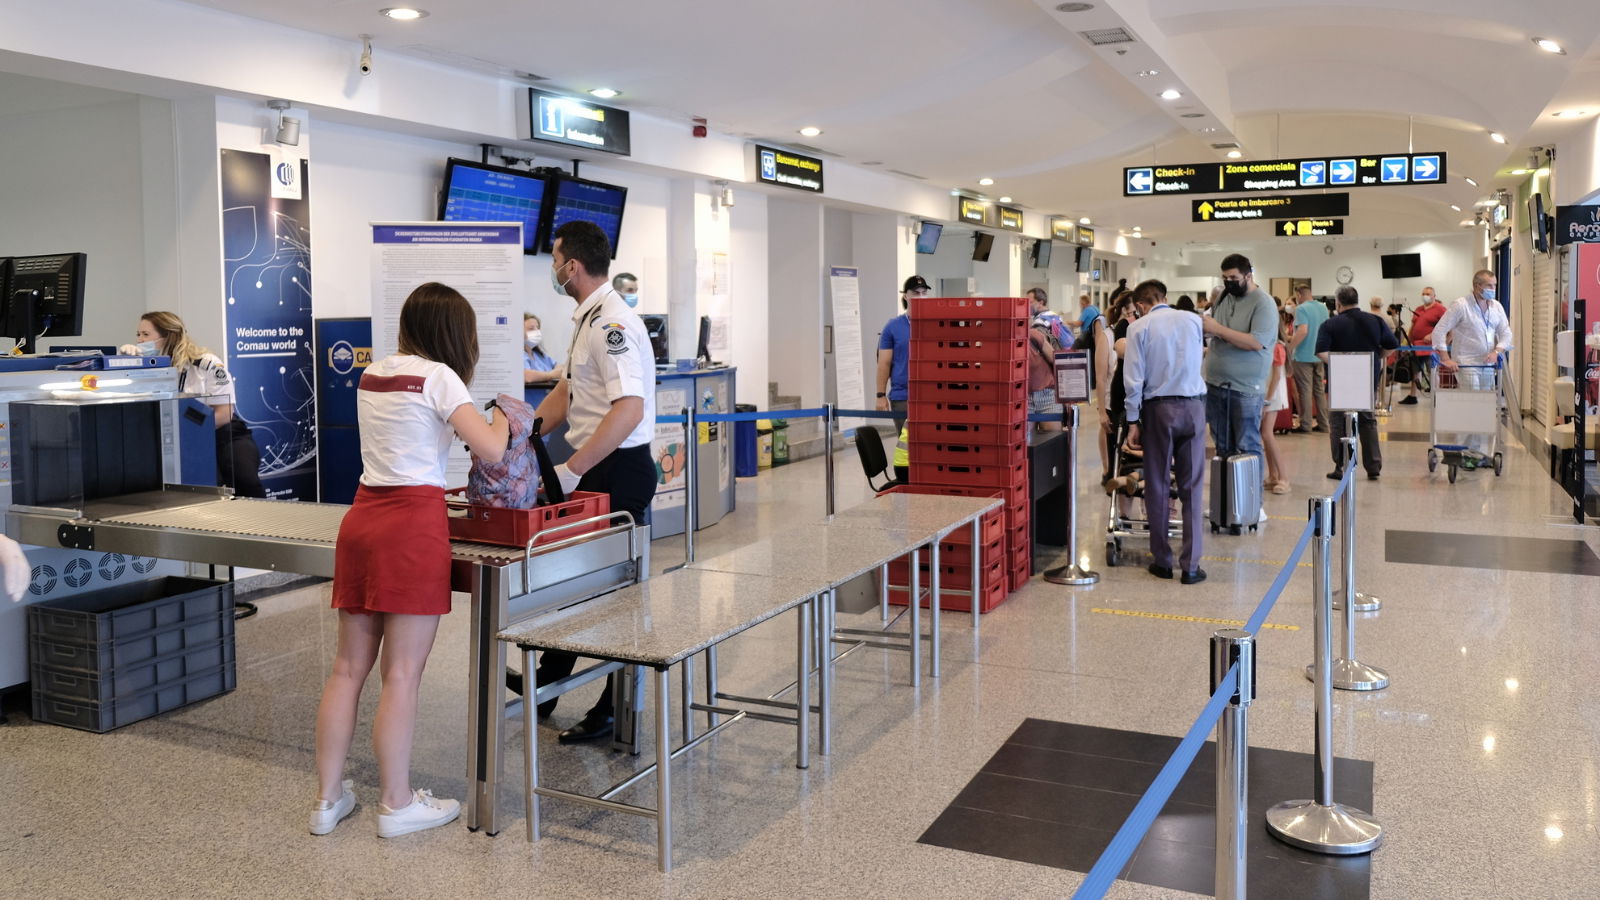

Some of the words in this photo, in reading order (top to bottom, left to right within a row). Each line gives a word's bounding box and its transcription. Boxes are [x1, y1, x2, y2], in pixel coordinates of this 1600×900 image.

[1360, 158, 1377, 168] Bar
[1155, 168, 1195, 178] Check-in
[1226, 165, 1248, 174] Zona
[1362, 175, 1376, 183] Bar
[1155, 181, 1190, 191] Check-in
[1243, 179, 1279, 190] Shopping
[1279, 179, 1297, 188] Area
[1214, 200, 1238, 208] Poarta
[1286, 197, 1291, 205] 3
[1214, 210, 1242, 219] Boarding
[1242, 209, 1257, 218] Gate
[236, 327, 277, 337] Welcome
[279, 326, 288, 336] to
[289, 326, 304, 336] the
[236, 341, 270, 351] Comau
[271, 339, 297, 350] world
